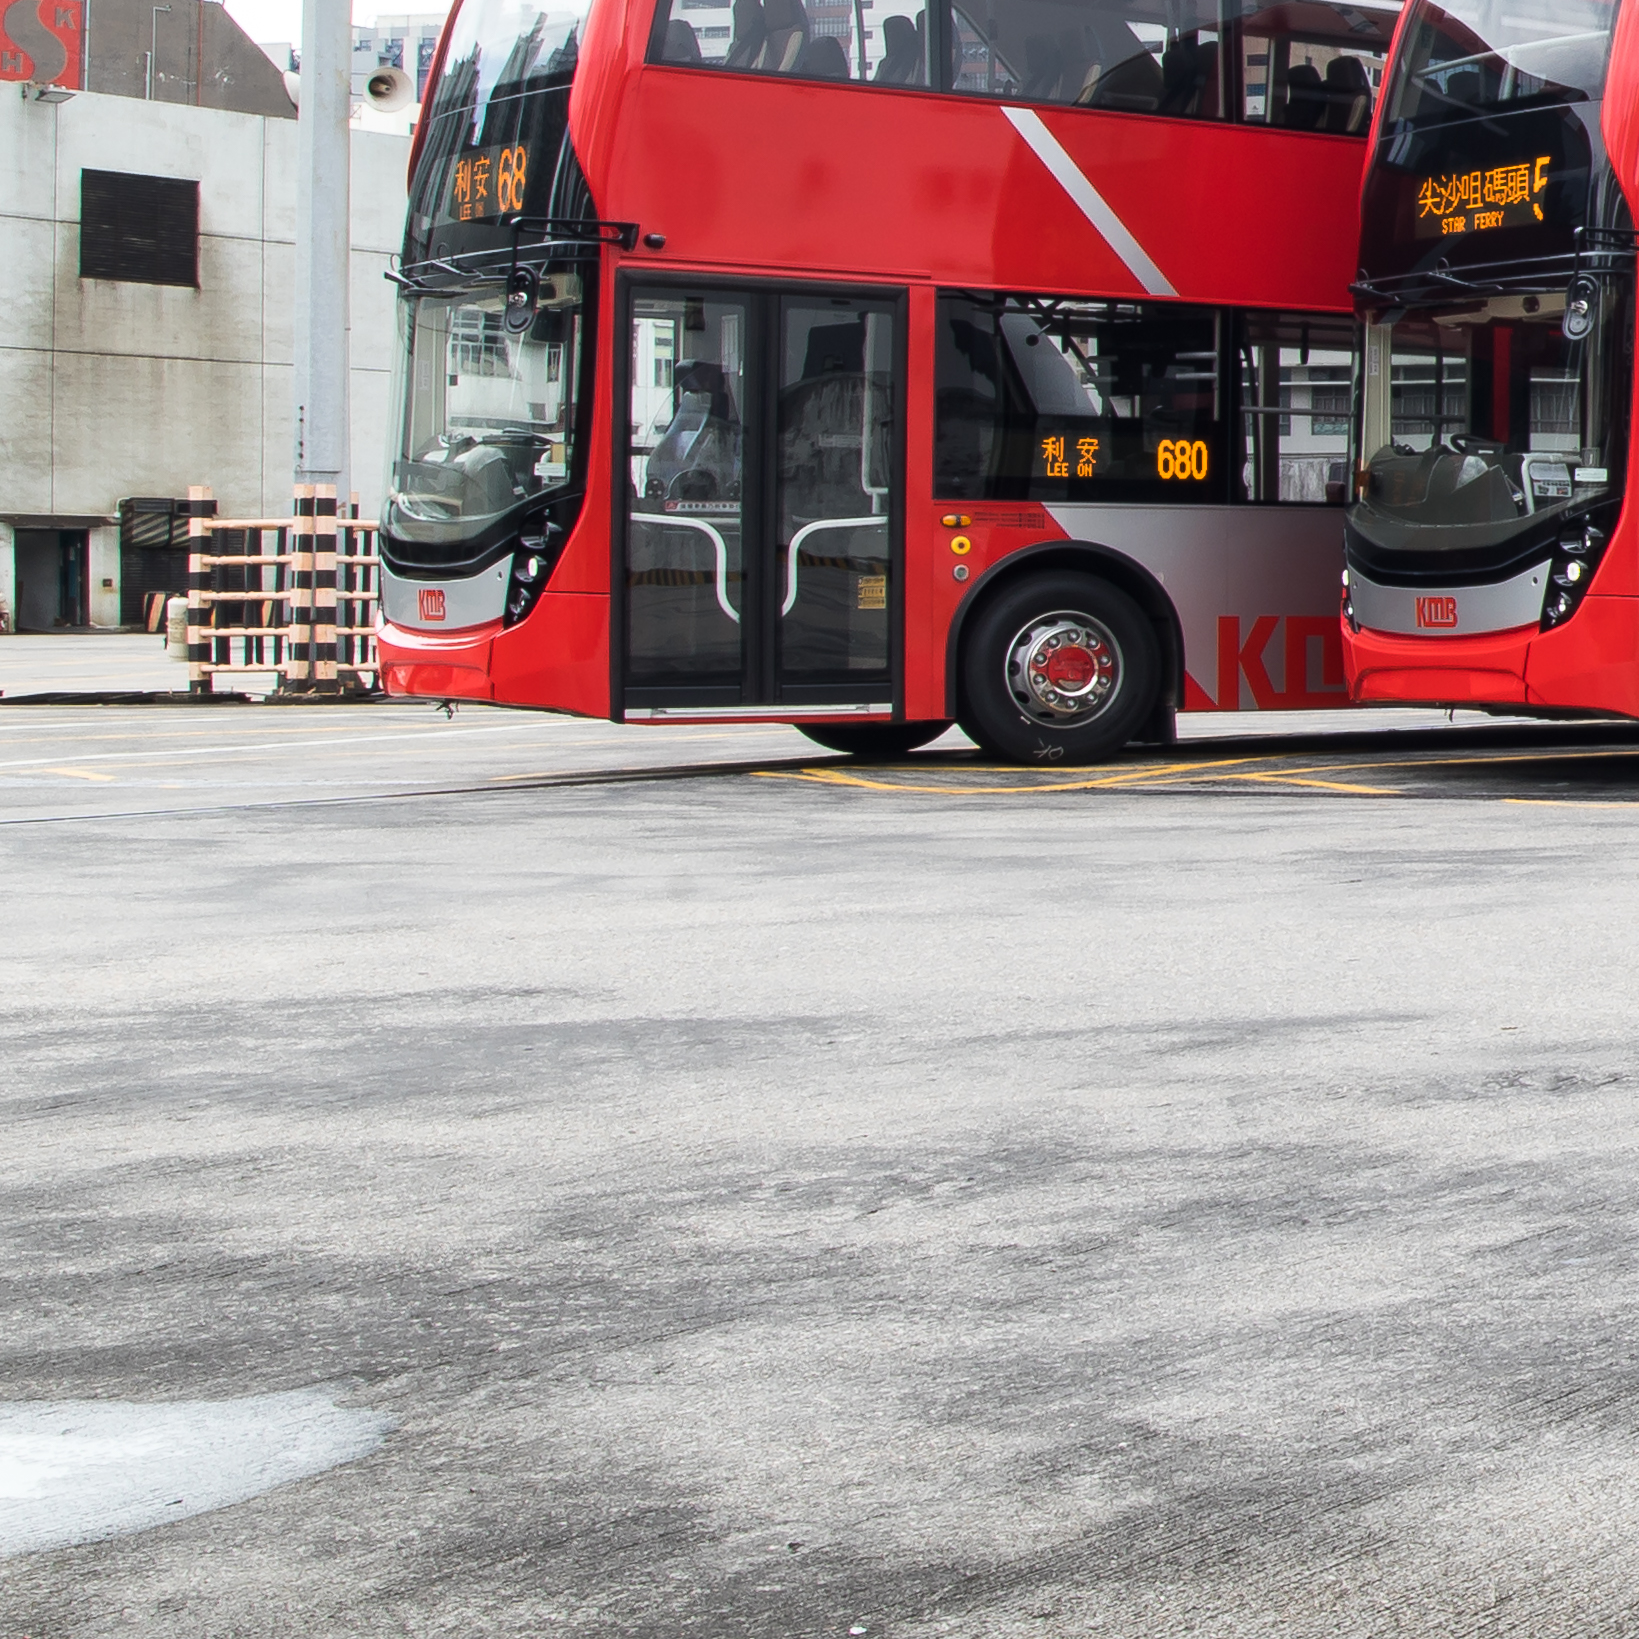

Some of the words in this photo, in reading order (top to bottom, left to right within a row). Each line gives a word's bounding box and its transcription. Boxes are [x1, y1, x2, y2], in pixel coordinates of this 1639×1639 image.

[454, 156, 490, 202] 利安
[1418, 164, 1530, 218] 尖沙咀碼頭
[1441, 216, 1466, 234] STAR
[1474, 211, 1504, 230] FERRY
[1047, 463, 1069, 477] LEE
[1077, 464, 1093, 477] ON
[1157, 439, 1208, 480] 680
[418, 589, 445, 621] KMB
[1415, 597, 1458, 629] KMB
